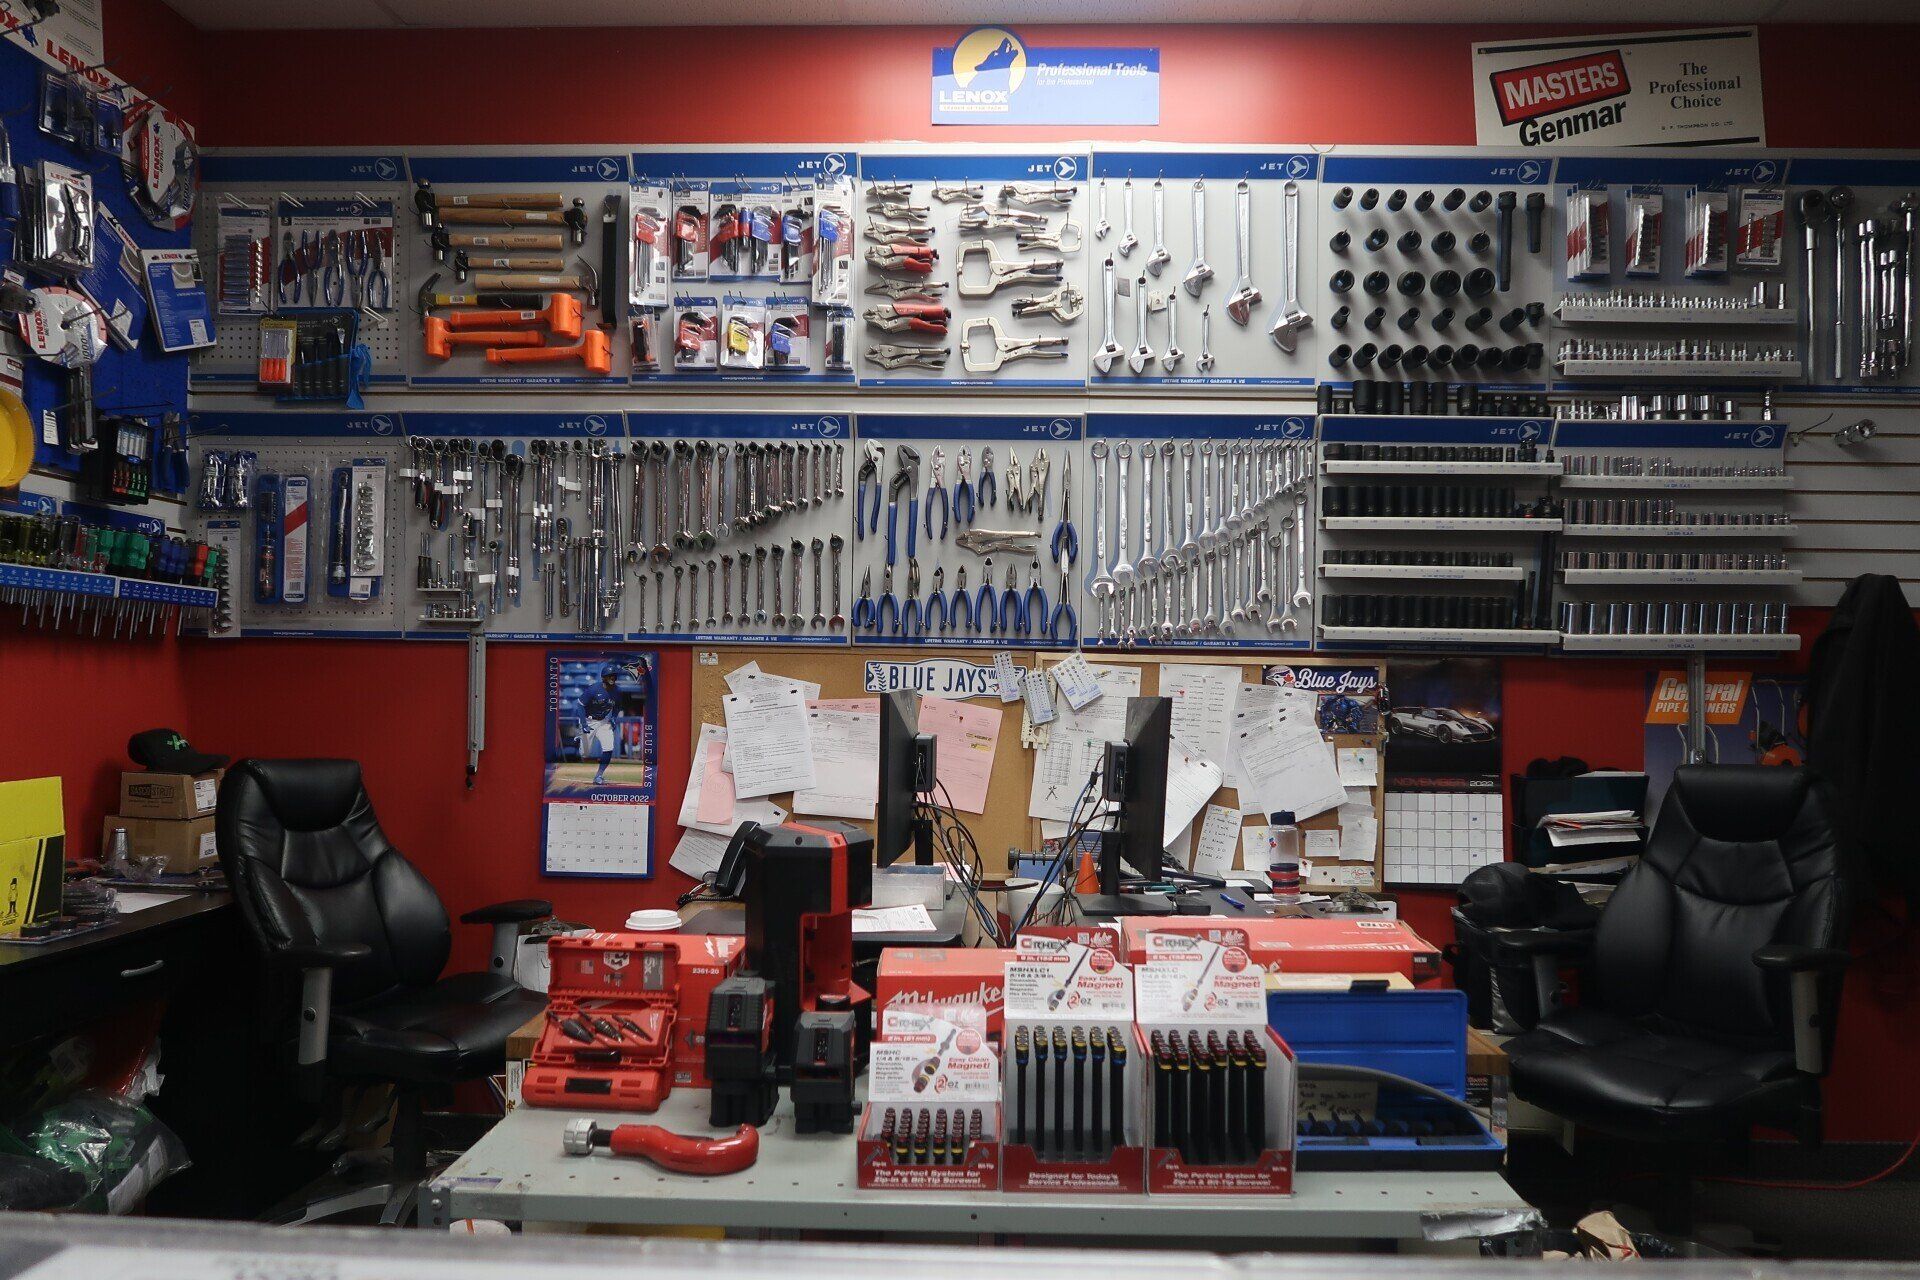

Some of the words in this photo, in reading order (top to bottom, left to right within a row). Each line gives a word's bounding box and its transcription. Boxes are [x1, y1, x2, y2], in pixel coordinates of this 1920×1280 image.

[47, 38, 110, 89] LENOX
[1679, 62, 1708, 75] The
[1037, 63, 1113, 76] Professional
[1115, 63, 1148, 76] Tools
[1503, 62, 1620, 110] MASTERS
[1649, 76, 1742, 94] Professional
[939, 90, 1008, 103] LENOX
[1670, 94, 1722, 109] Choice
[1519, 101, 1626, 147] Genmar
[350, 165, 373, 173] JET
[571, 165, 595, 173] JET
[797, 161, 822, 169] JET
[1027, 164, 1052, 173] JET
[1260, 162, 1284, 170] JET
[1490, 167, 1515, 176] JET
[1725, 167, 1750, 176] JET
[34, 310, 47, 350] LENOX
[346, 421, 369, 429] JET
[1724, 432, 1749, 440] JET
[21, 500, 38, 508] JET
[550, 657, 558, 711] TORONTO
[889, 665, 936, 692] BLUE
[943, 668, 987, 693] JAYS
[1295, 667, 1336, 689] Blue
[1336, 670, 1377, 694] Jays
[1659, 678, 1743, 701] Geeral
[1655, 702, 1681, 712] PIPE
[643, 725, 653, 754] BLUE
[643, 759, 652, 788] JAYS
[1394, 778, 1466, 787] NOVEMBER
[591, 793, 629, 802] OCTOBER
[630, 795, 650, 803] 2022
[1077, 981, 1124, 990] Magnet!
[1213, 981, 1261, 990] Magnet!
[947, 1062, 991, 1071] Magnet!
[930, 1170, 964, 1178] System
